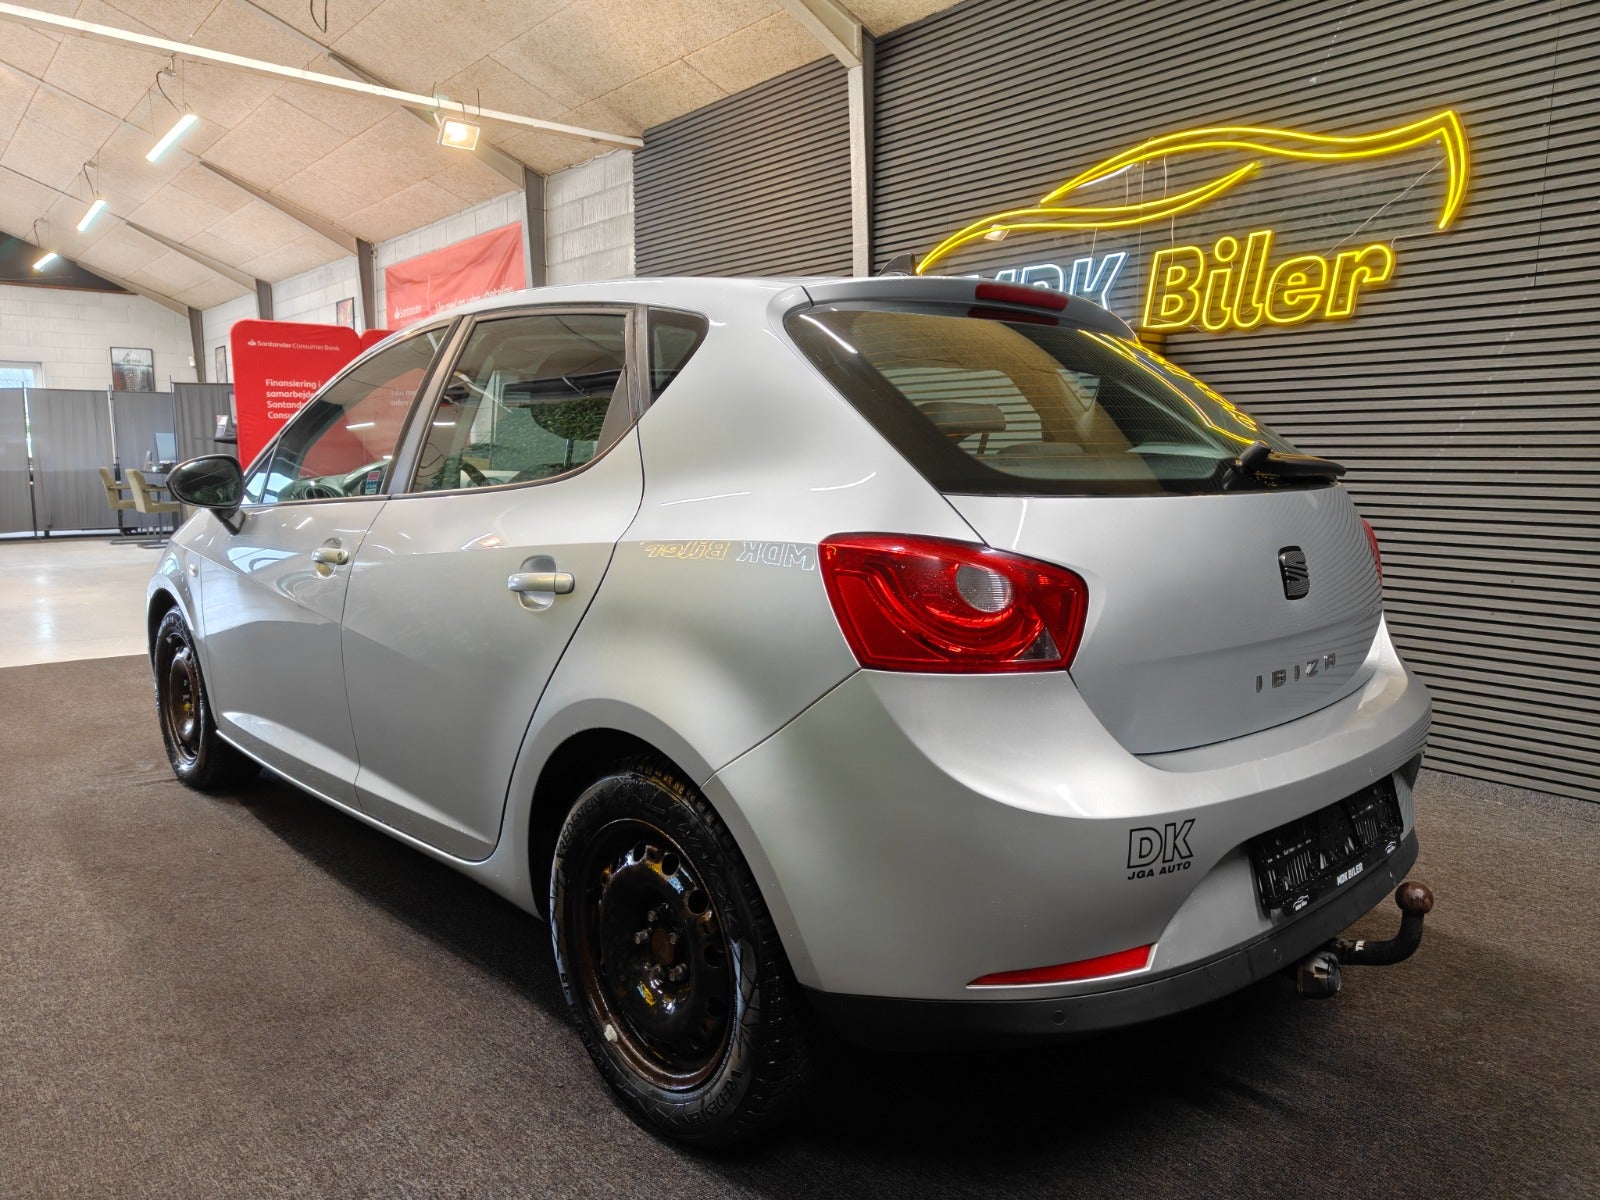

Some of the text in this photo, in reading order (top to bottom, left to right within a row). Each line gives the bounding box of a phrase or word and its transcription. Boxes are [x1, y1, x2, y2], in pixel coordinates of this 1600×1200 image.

[1143, 230, 1394, 330] Biler
[257, 340, 291, 349] Santander
[292, 342, 324, 350] Consumer
[265, 379, 317, 389] Finansiering
[267, 400, 304, 409] Santand
[1256, 652, 1337, 694] IBIZA
[1127, 818, 1195, 869] DK
[1128, 861, 1191, 880] JGA AUTO
[1347, 862, 1363, 880] BILER
